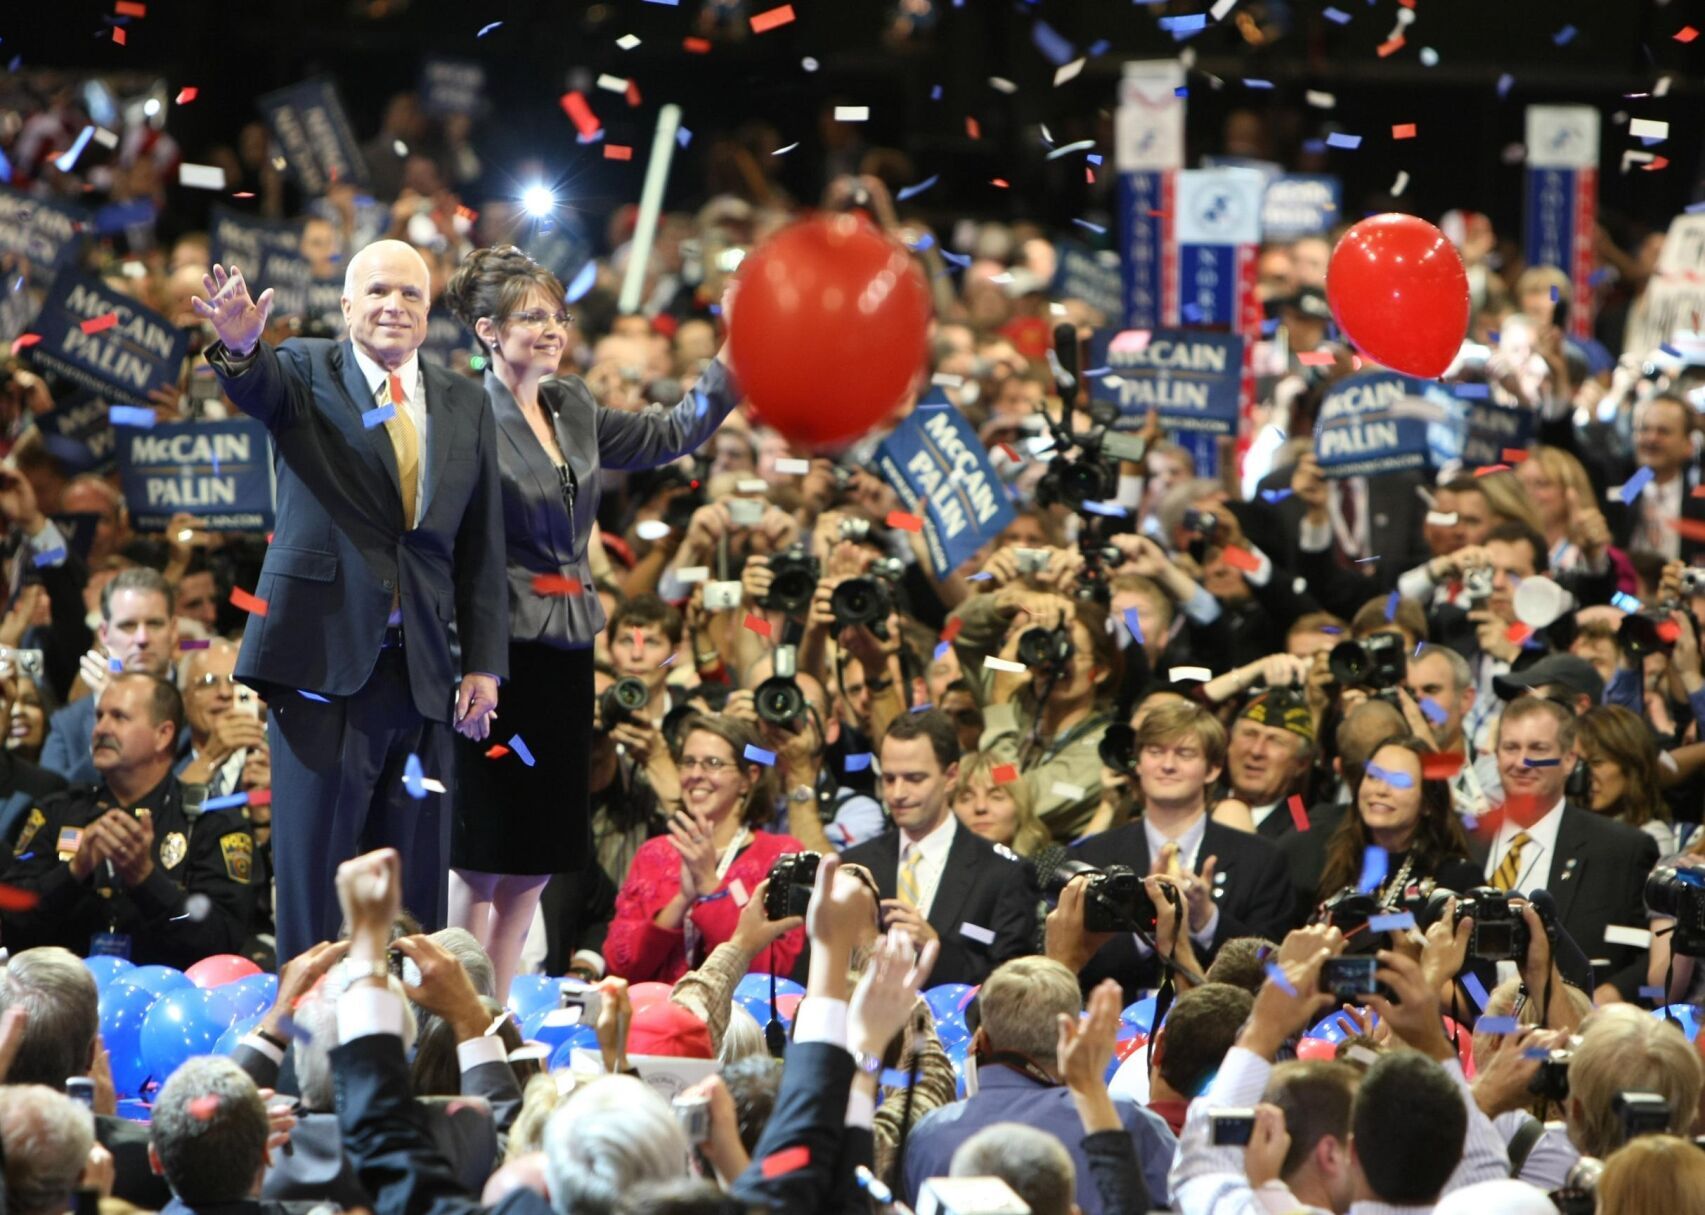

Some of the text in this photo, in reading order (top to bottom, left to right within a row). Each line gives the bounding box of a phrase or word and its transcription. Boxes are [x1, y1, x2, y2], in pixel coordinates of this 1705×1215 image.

[62, 326, 152, 388] PALIN
[1118, 379, 1209, 409] PALIN
[131, 434, 249, 464] McCAIN
[924, 412, 999, 524] McCAIN
[147, 477, 236, 506] PALIN
[907, 450, 967, 540] PALIN
